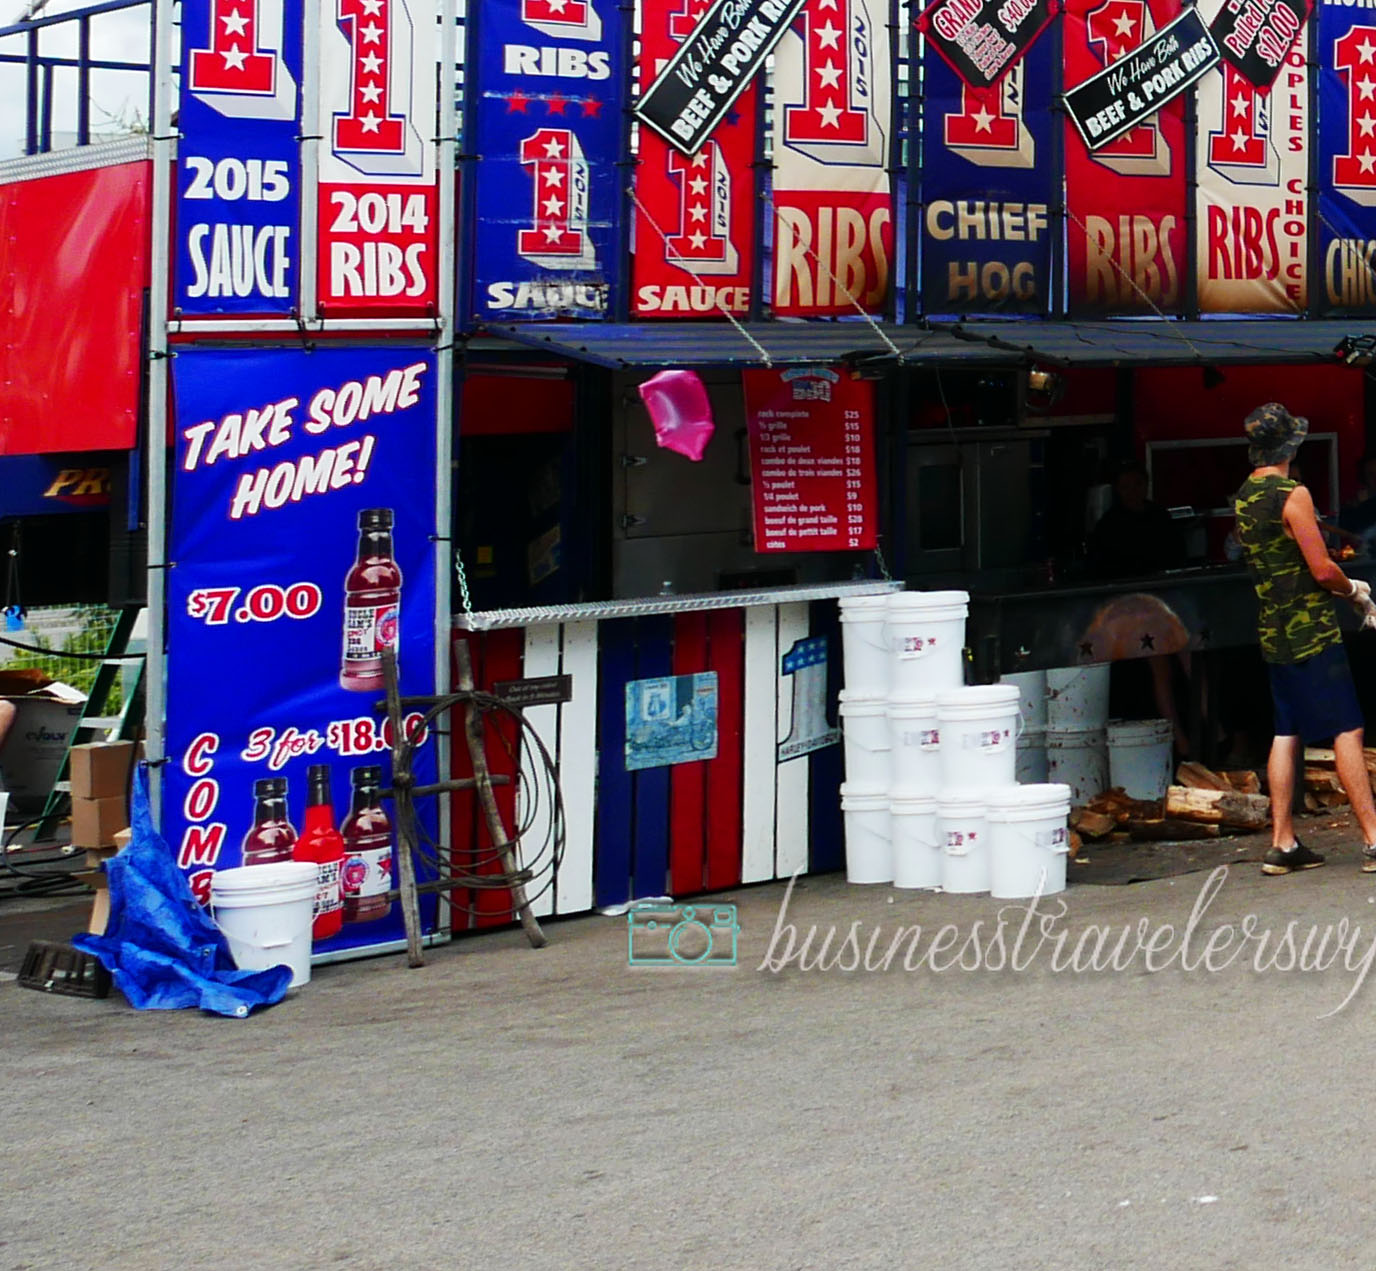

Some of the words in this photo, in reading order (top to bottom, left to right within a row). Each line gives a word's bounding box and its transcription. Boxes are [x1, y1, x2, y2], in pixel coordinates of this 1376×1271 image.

[503, 44, 612, 82] RIBS
[1107, 69, 1129, 96] We
[1130, 57, 1157, 84] Have
[1129, 91, 1147, 112] &
[184, 155, 291, 203] 2015
[329, 191, 430, 236] 2014
[926, 200, 1049, 241] CHIEF
[187, 222, 291, 299] SAUCE
[775, 205, 891, 309] RIBS
[1085, 214, 1179, 308] RIBS
[1207, 203, 1282, 281] RIBS
[329, 241, 428, 299] RIBS
[636, 285, 752, 313] SAUCE
[184, 397, 300, 472] TAKE
[305, 362, 429, 435] SOME
[230, 435, 377, 520] HOME!
[187, 581, 322, 624] $7.00
